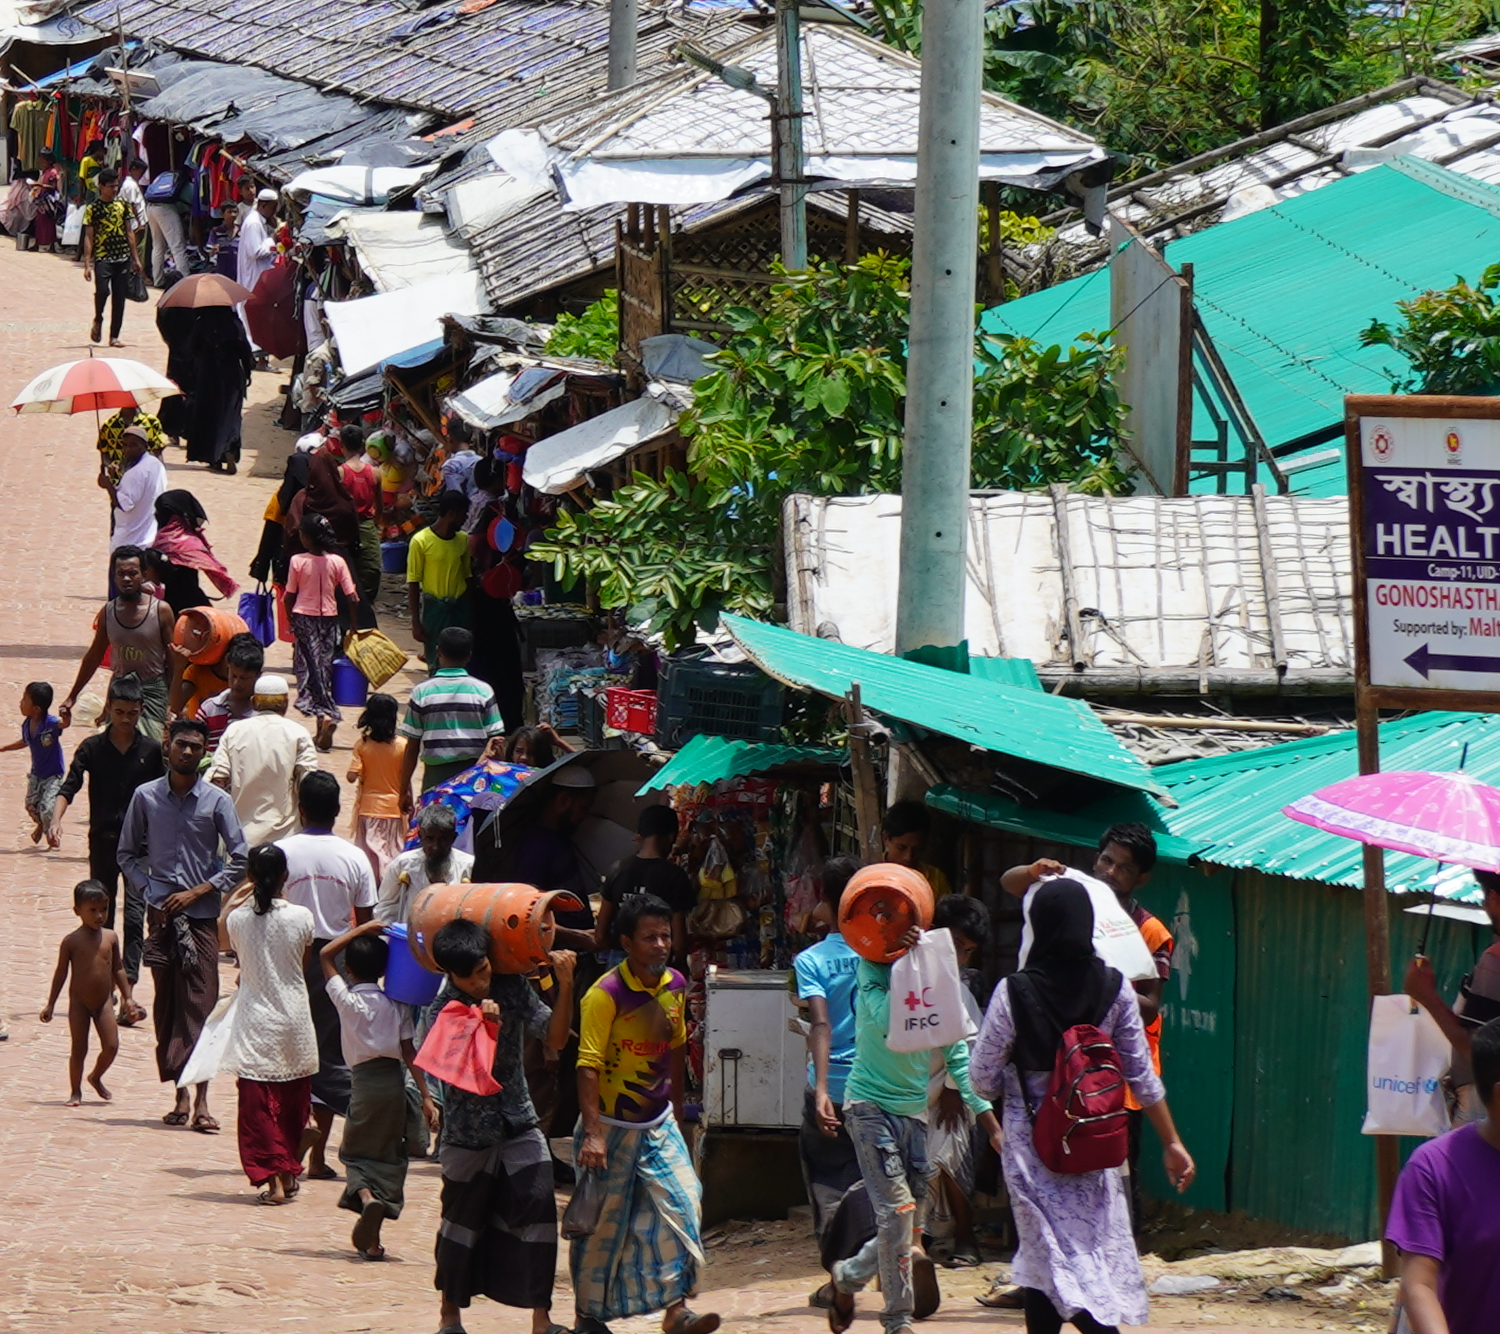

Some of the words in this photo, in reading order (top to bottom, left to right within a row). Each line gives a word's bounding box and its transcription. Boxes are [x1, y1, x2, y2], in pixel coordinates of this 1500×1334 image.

[1393, 619, 1449, 636] Supported
[1451, 620, 1467, 639] by:
[1372, 1074, 1422, 1094] unicef
